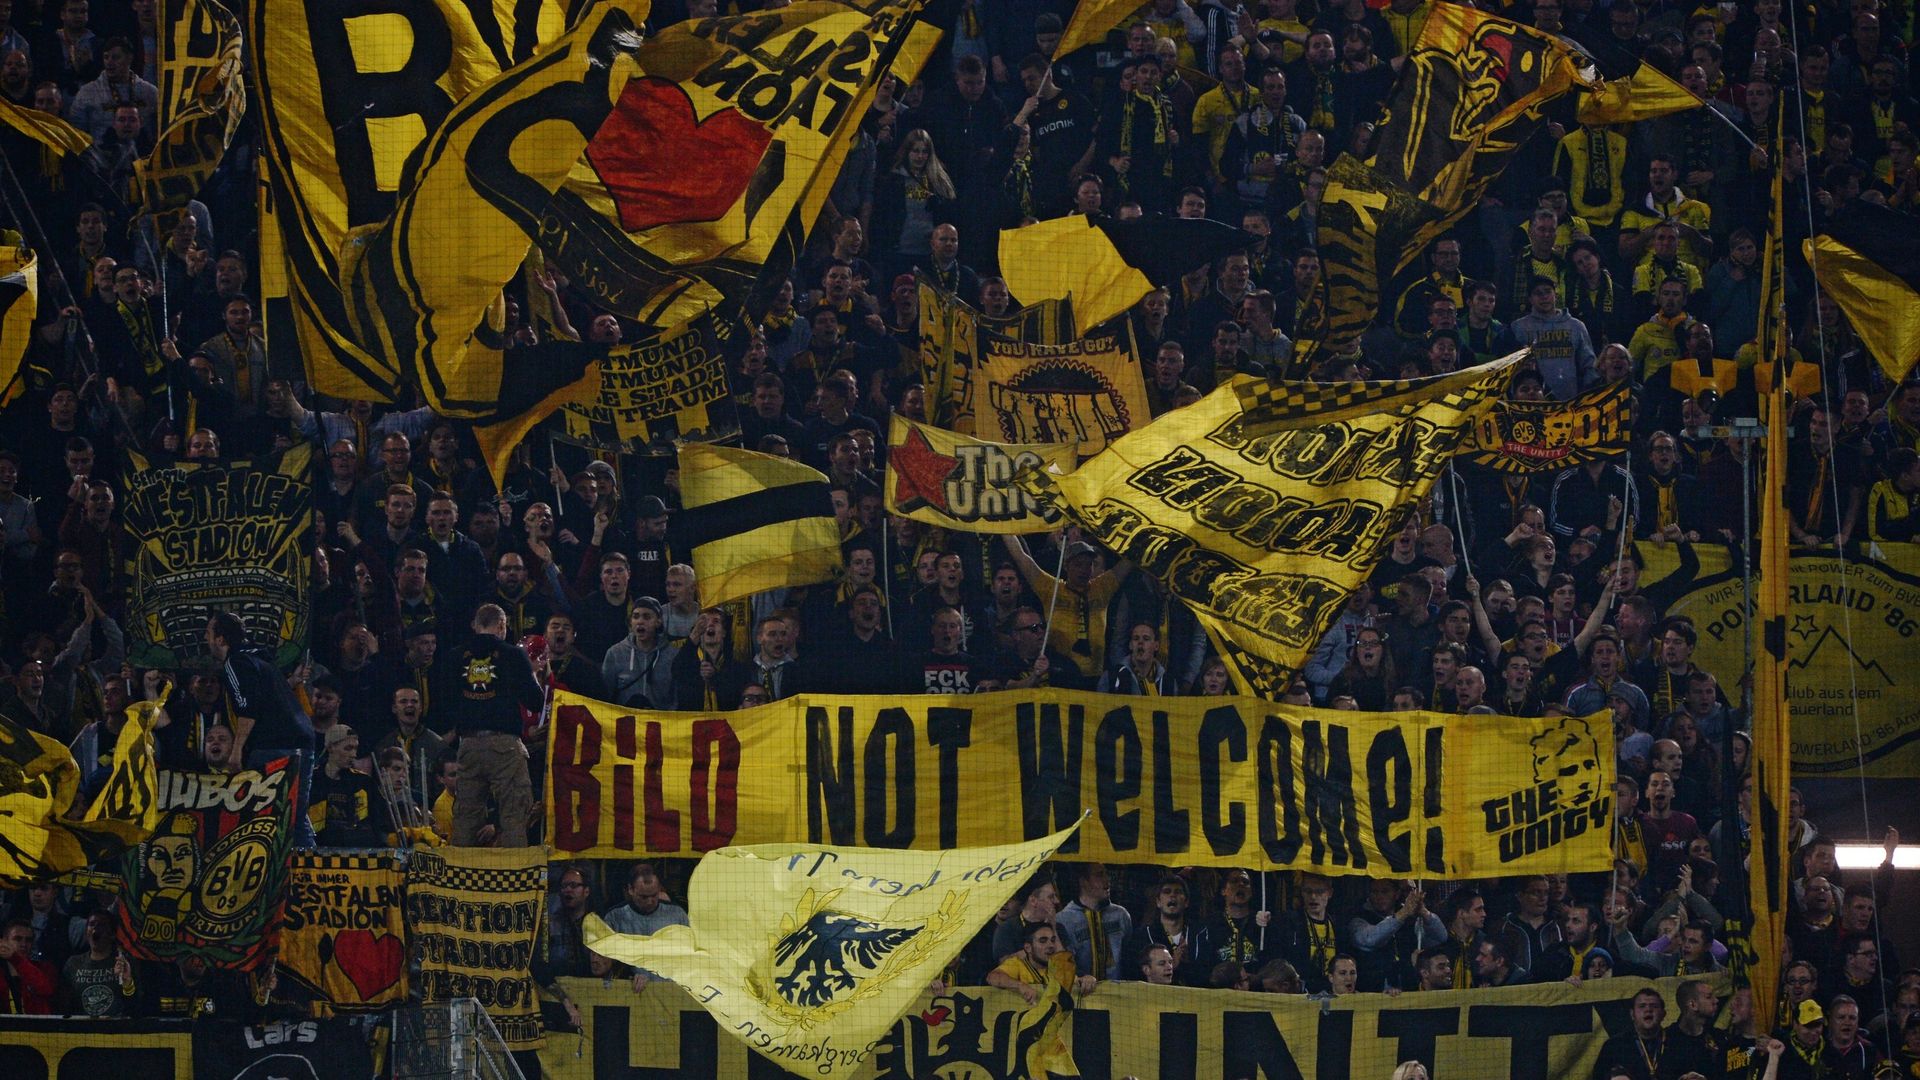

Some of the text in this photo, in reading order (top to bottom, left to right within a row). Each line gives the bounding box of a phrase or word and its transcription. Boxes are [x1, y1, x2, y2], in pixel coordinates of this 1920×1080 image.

[1039, 118, 1074, 136] EVONIK
[991, 340, 1024, 356] YOU
[619, 379, 727, 422] TRAUM
[1514, 420, 1535, 438] BVB
[1508, 443, 1563, 458] THE UNITY
[946, 481, 1062, 524] Unit
[1809, 563, 1863, 578] POWER
[1705, 586, 1736, 605] WIR
[1706, 583, 1875, 642] POWRLAND
[924, 669, 971, 687] FCK
[1819, 689, 1844, 699] aus
[1849, 685, 1881, 699] dem
[1790, 703, 1853, 717] auerland
[1791, 734, 1872, 756] OWERLAND
[805, 705, 973, 850] NOT
[1481, 779, 1558, 834] THE
[1499, 796, 1611, 862] UNITY
[204, 820, 278, 864] BORUSSI
[206, 846, 265, 897] BVB
[292, 872, 350, 884] FÜR IMMER
[217, 895, 238, 910] 09
[290, 885, 403, 908] ESTFALEN
[284, 905, 388, 930] STADION
[244, 1021, 319, 1050] Lars
[1072, 1004, 1640, 1080] UNIT
